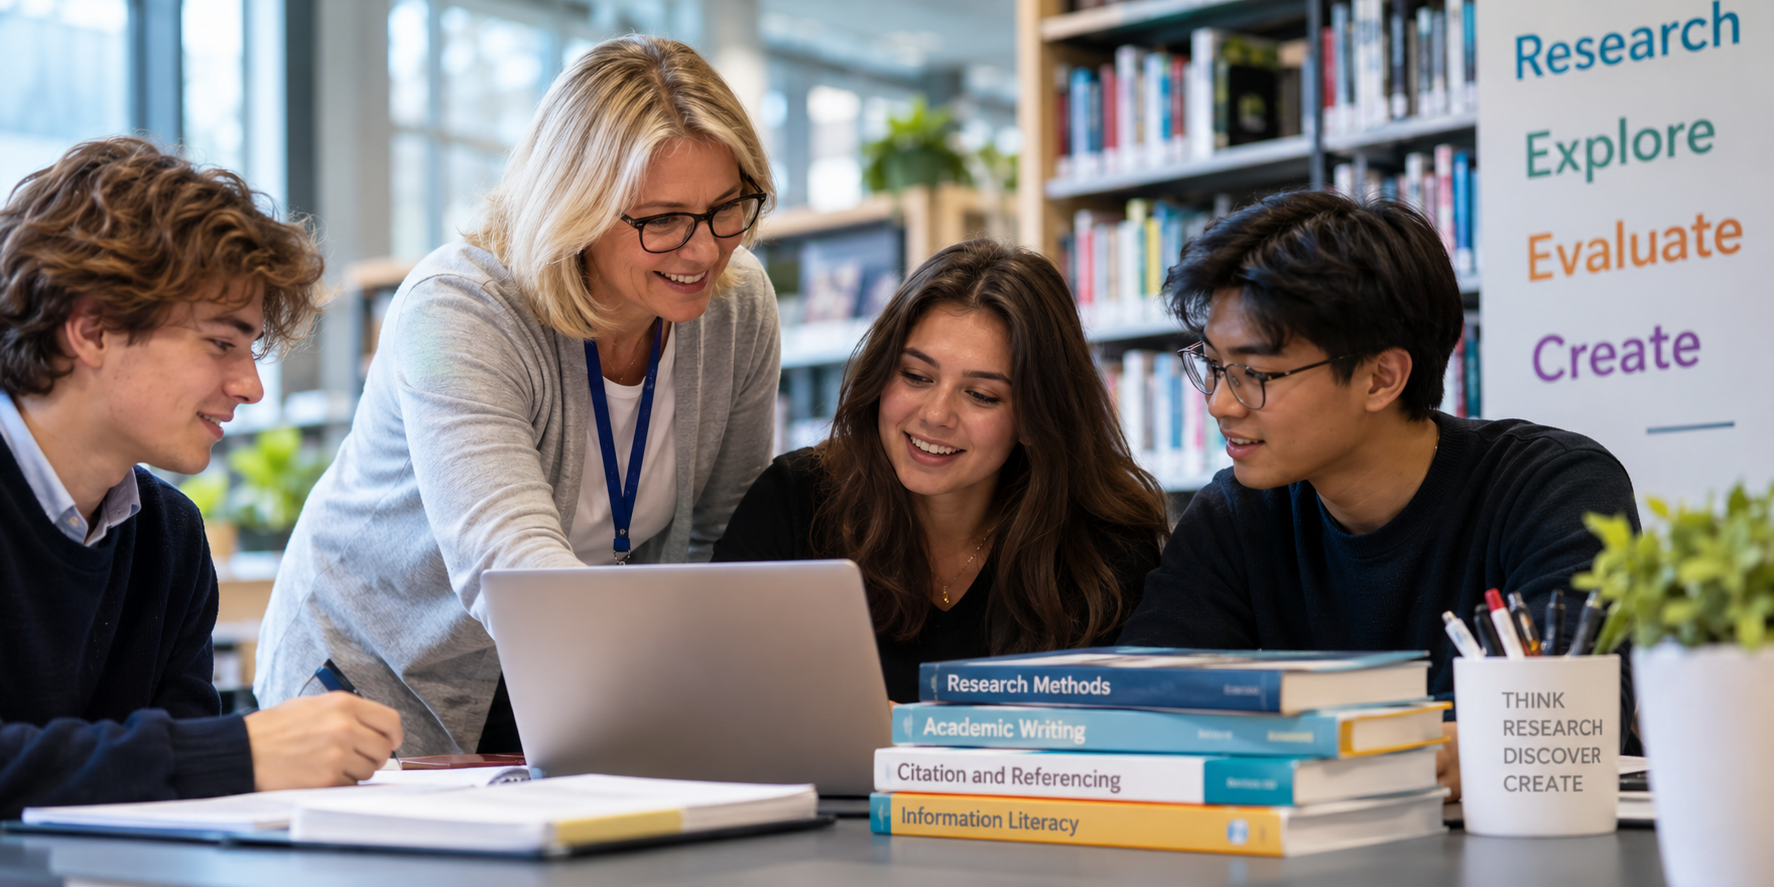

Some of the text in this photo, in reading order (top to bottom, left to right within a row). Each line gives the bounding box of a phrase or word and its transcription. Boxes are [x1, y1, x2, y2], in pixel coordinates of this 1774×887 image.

[1514, 1, 1741, 80] Research
[1526, 117, 1715, 184] Explore
[1527, 213, 1743, 282] Evaluate
[1532, 325, 1701, 383] Create
[947, 674, 1111, 695] Research Methods
[1502, 692, 1565, 709] THINK
[923, 716, 1086, 745] Academic Writing
[1503, 719, 1603, 737] RESEARCH
[1503, 747, 1601, 764] DISCOVER
[897, 762, 1121, 794] Citation and Referencing
[1503, 775, 1583, 792] CREATE
[901, 806, 1079, 837] Information Literacy
